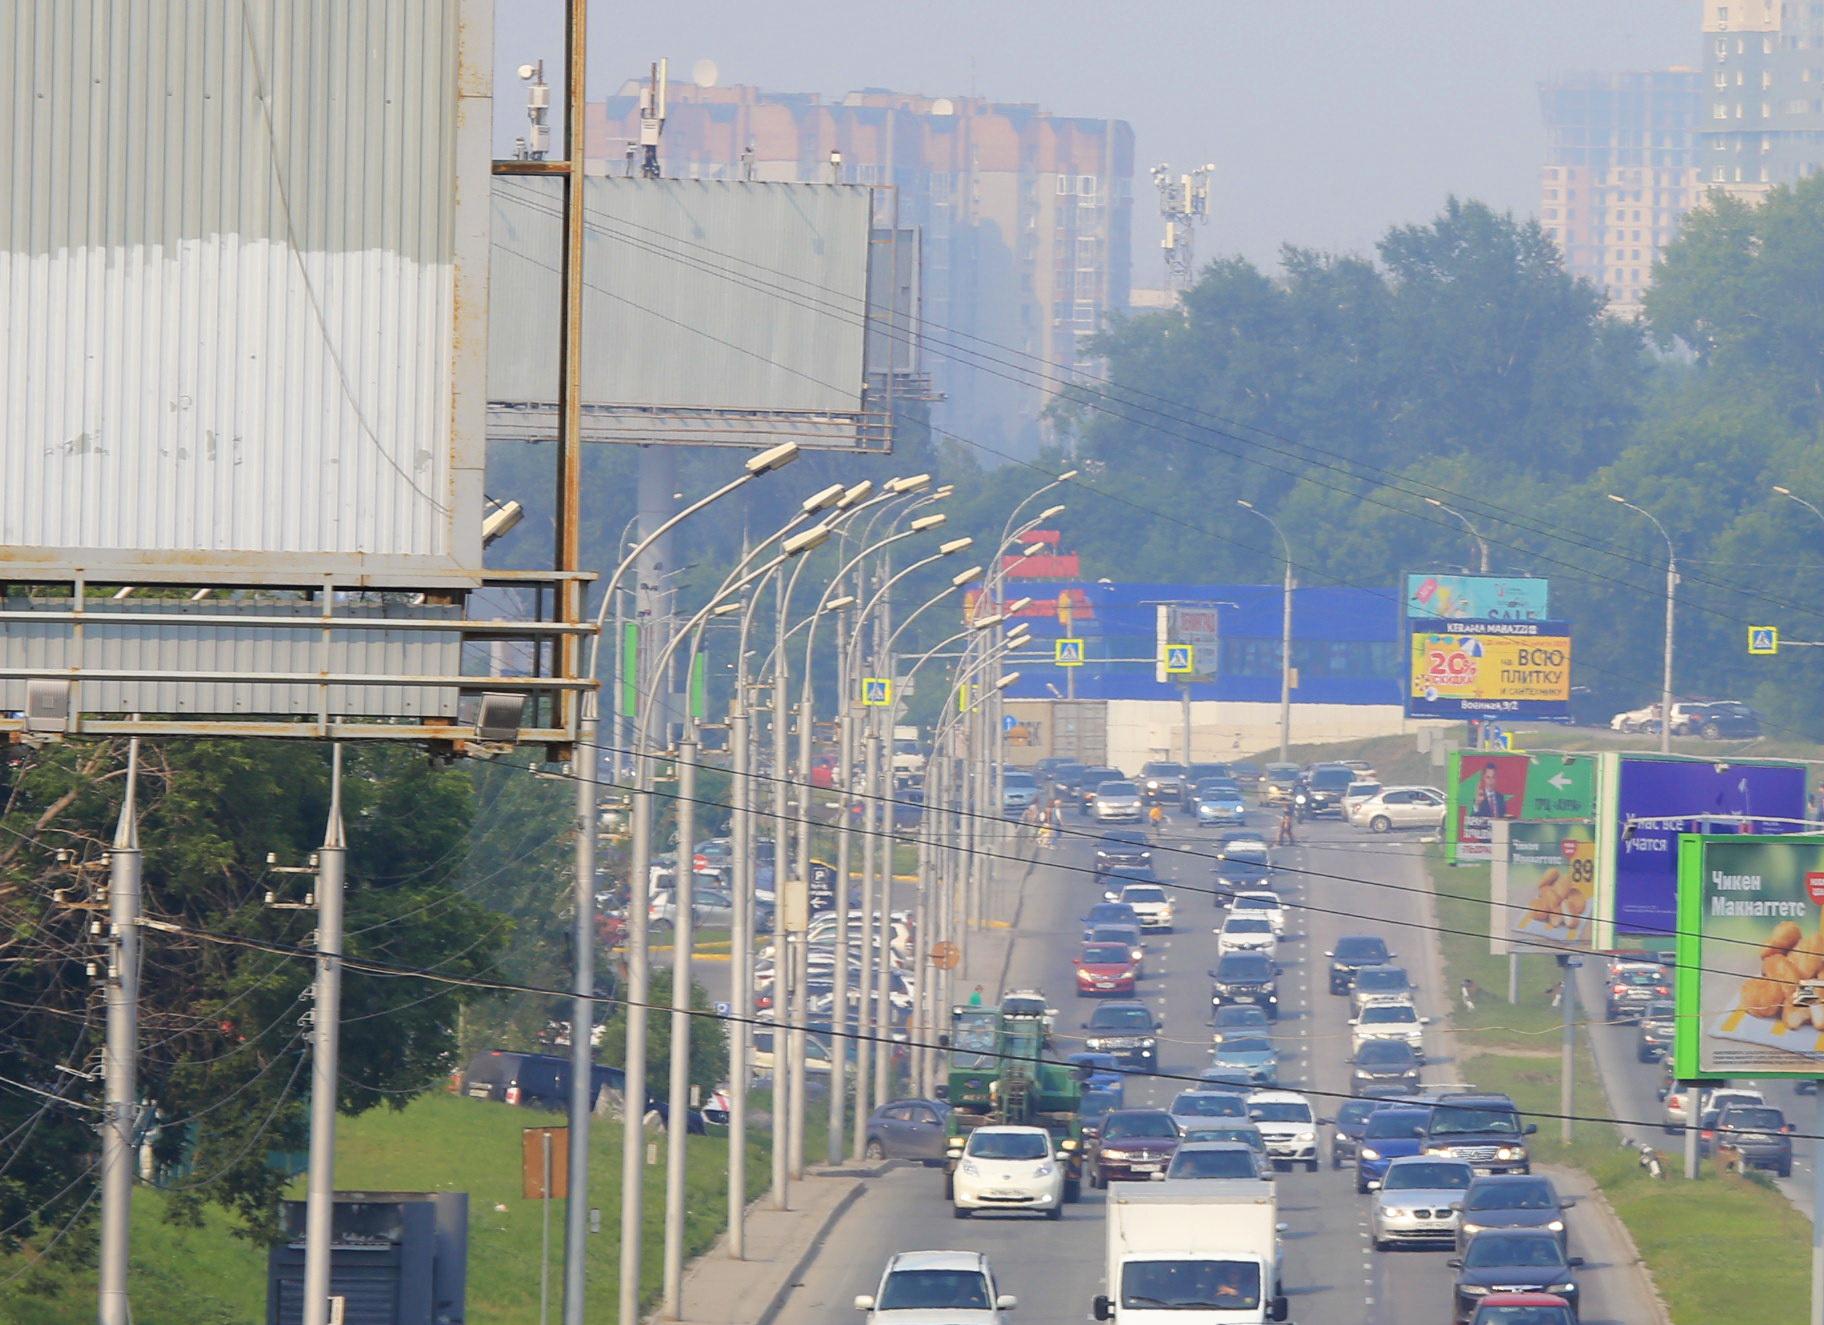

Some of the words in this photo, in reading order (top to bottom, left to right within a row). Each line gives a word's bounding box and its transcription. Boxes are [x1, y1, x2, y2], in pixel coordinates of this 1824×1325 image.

[1430, 651, 1476, 676] 20%
[1518, 648, 1564, 667] ВСЮ
[1501, 670, 1562, 684] ПЛИТКУ
[1625, 838, 1667, 853] учатся
[1711, 870, 1762, 891] Чикен
[1711, 896, 1807, 917] Макнаггетс
